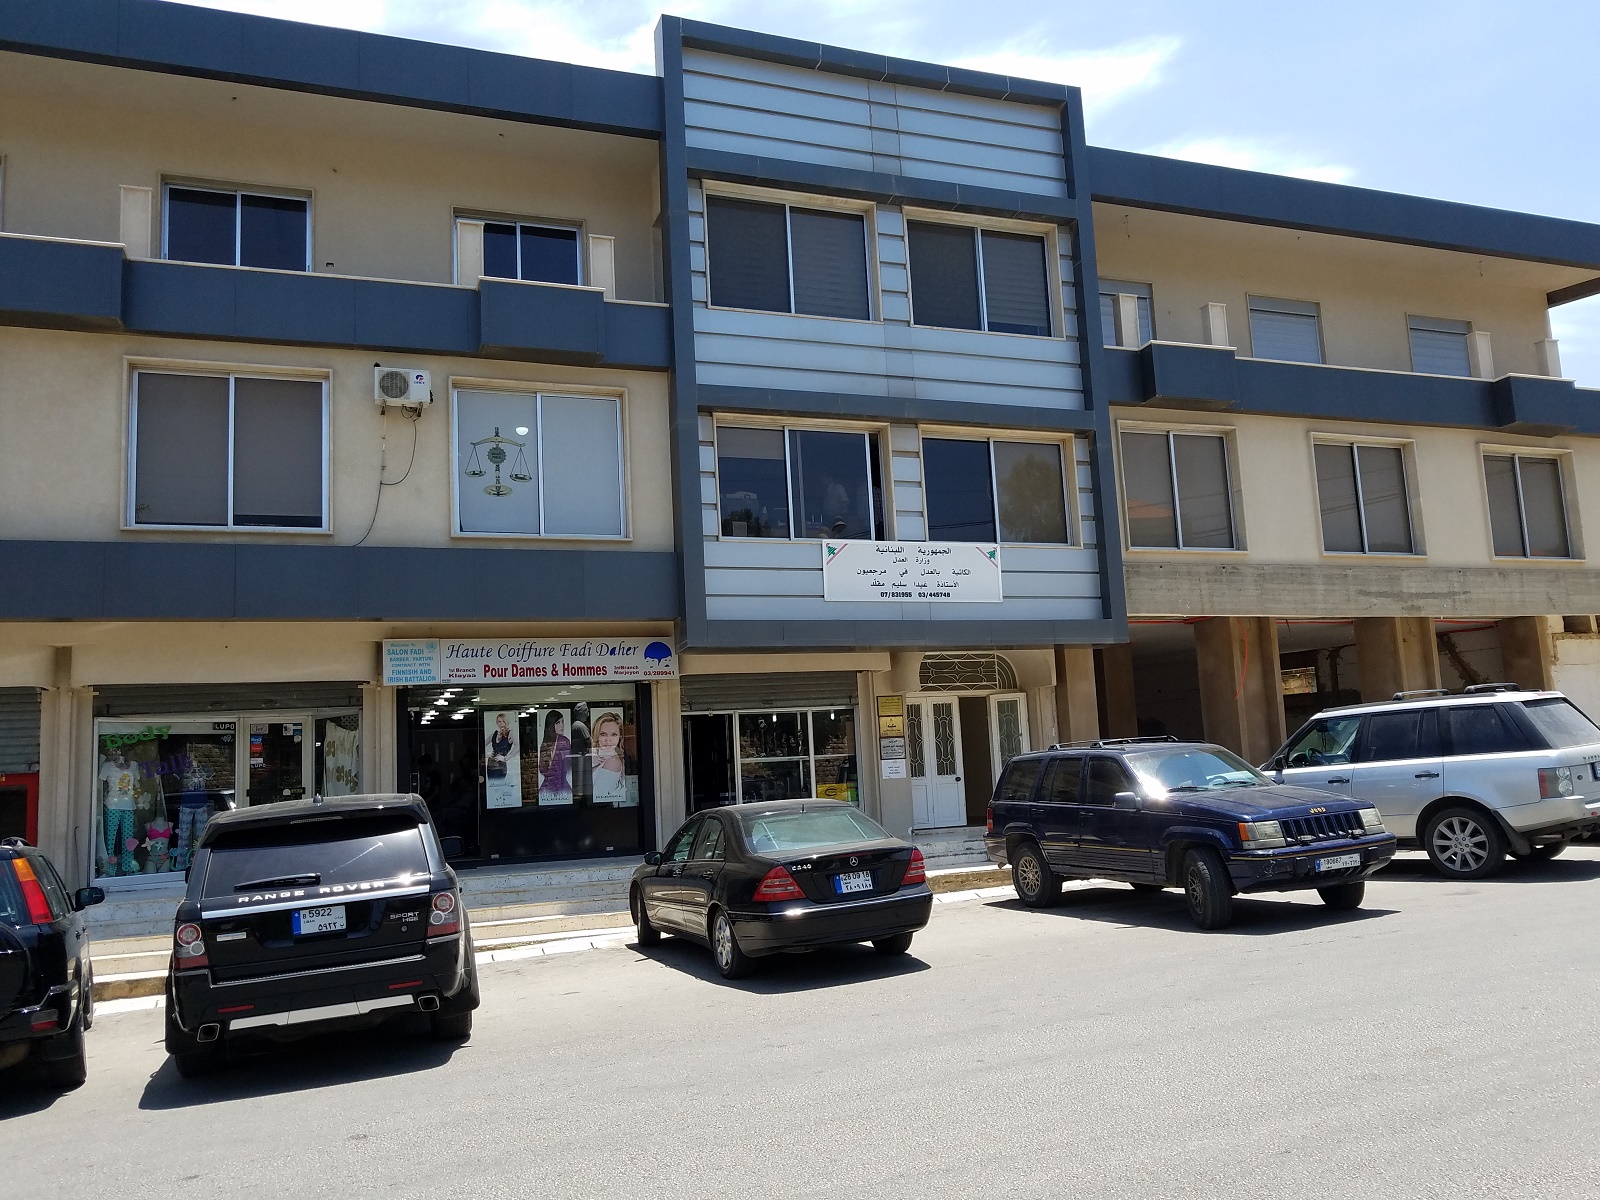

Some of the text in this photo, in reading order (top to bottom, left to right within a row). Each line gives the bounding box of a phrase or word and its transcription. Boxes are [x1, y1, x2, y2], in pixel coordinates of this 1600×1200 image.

[875, 545, 952, 556] الجمهورية اللبنانية
[915, 557, 930, 565] وزارة
[856, 567, 971, 577] الكاتبة بالعدل في مرجعيون
[891, 580, 908, 589] سليم
[445, 640, 639, 663] Haute Coiffure Fadi Daher
[483, 663, 608, 678] Pour Dames & Hommes
[101, 725, 171, 750] Body
[238, 881, 385, 903] RANGE ROVER
[308, 907, 332, 919] 5922
[390, 911, 420, 920] SPORT
